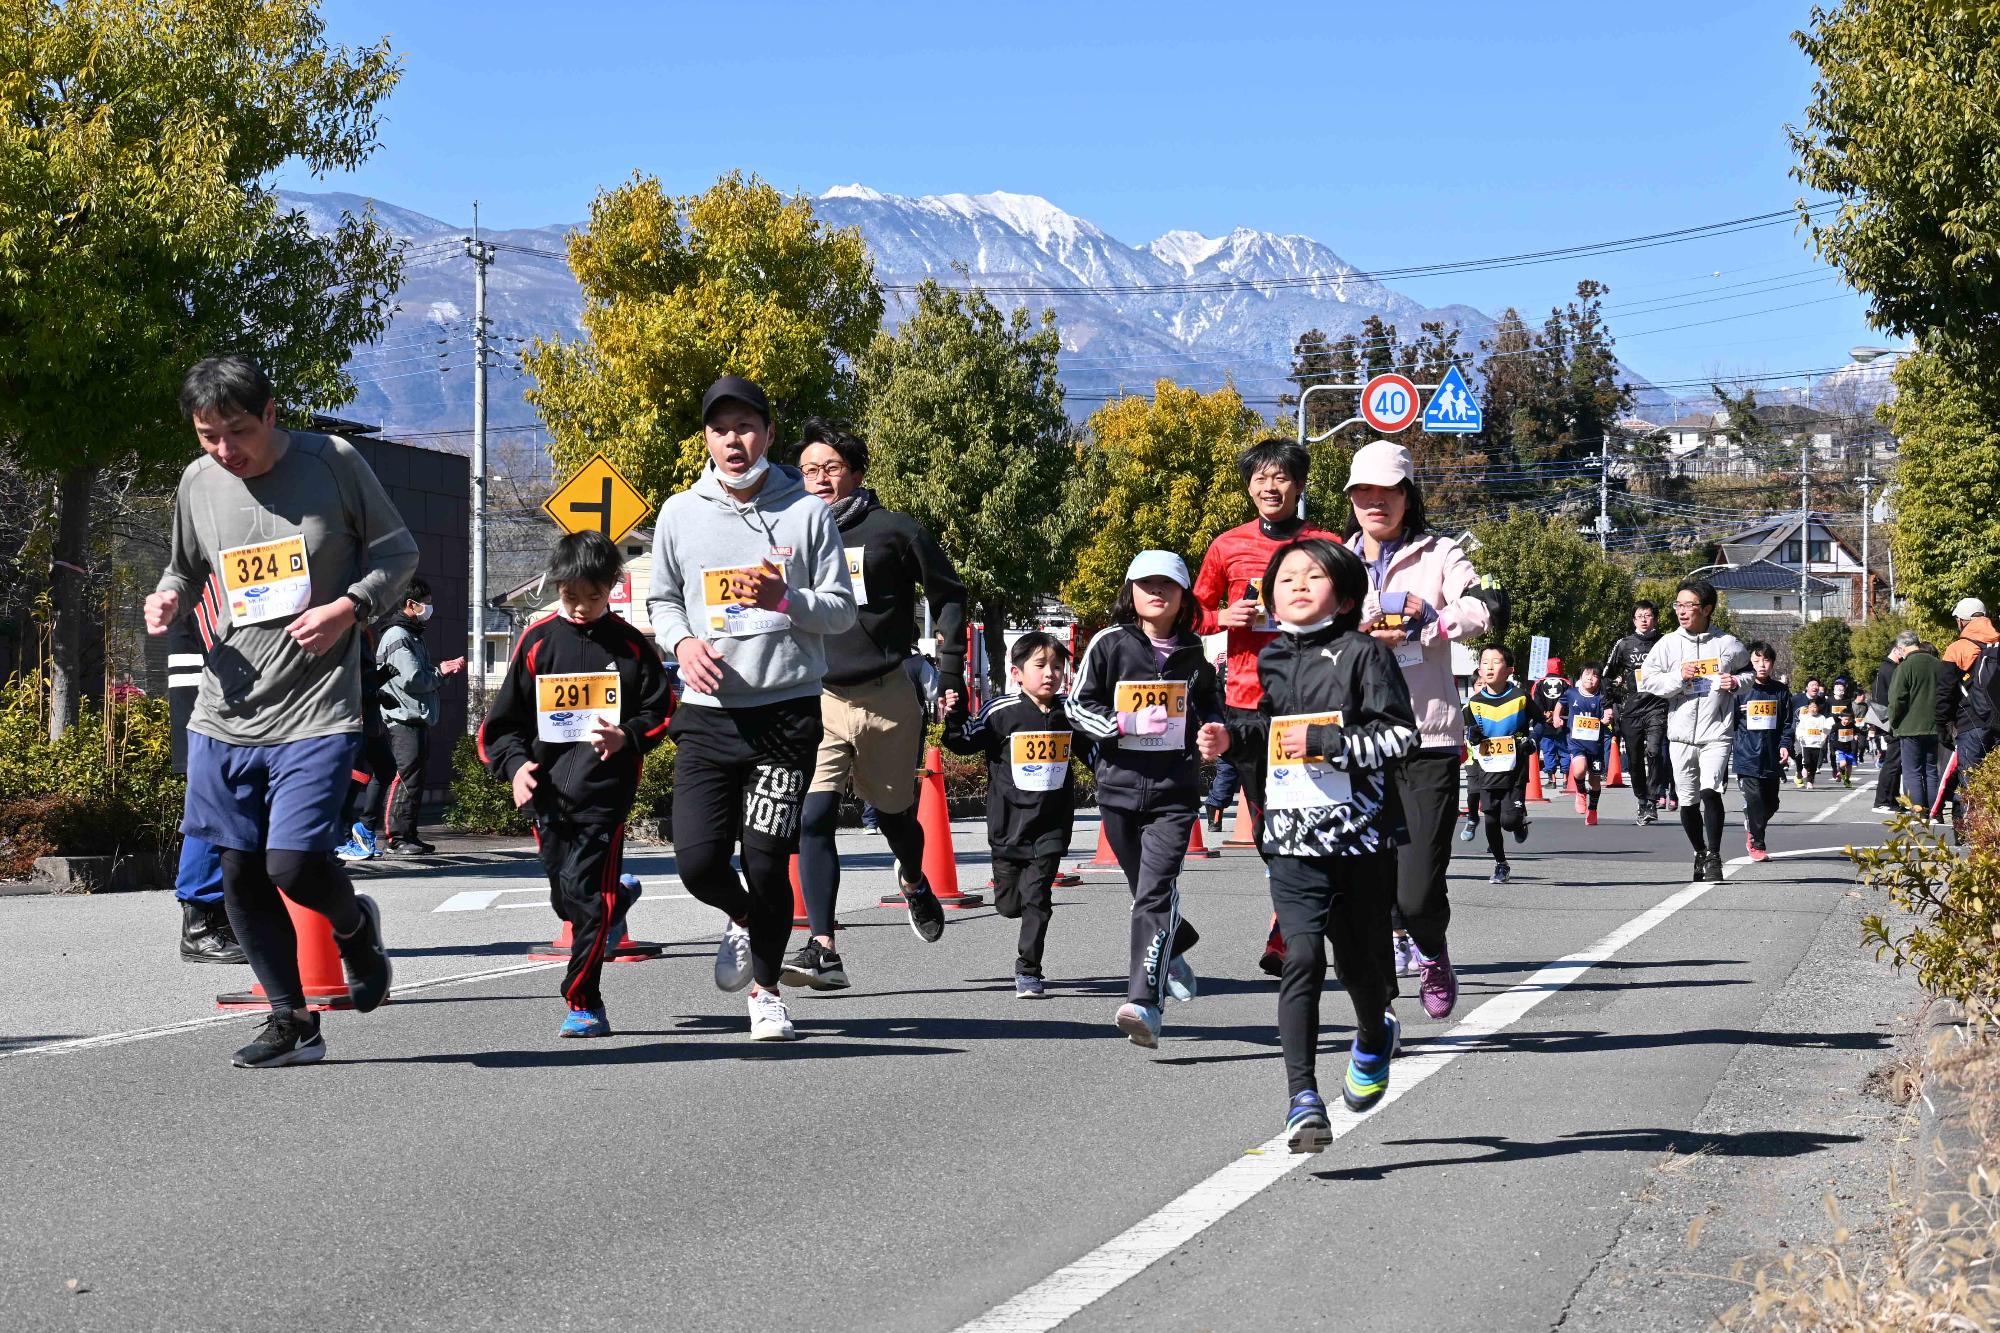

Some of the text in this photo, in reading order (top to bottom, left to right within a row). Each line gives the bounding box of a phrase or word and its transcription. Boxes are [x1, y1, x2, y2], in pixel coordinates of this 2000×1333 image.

[1375, 391, 1405, 416] 40
[237, 553, 302, 584] 324 D
[851, 562, 859, 572] D
[554, 683, 616, 708] 291 C
[1177, 698, 1184, 712] C
[1754, 704, 1770, 715] 245
[552, 720, 574, 728] MEIKO
[1026, 740, 1057, 760] 323
[1484, 742, 1503, 754] 252
[1045, 766, 1064, 774] メイコー
[1143, 928, 1166, 987] adidas
